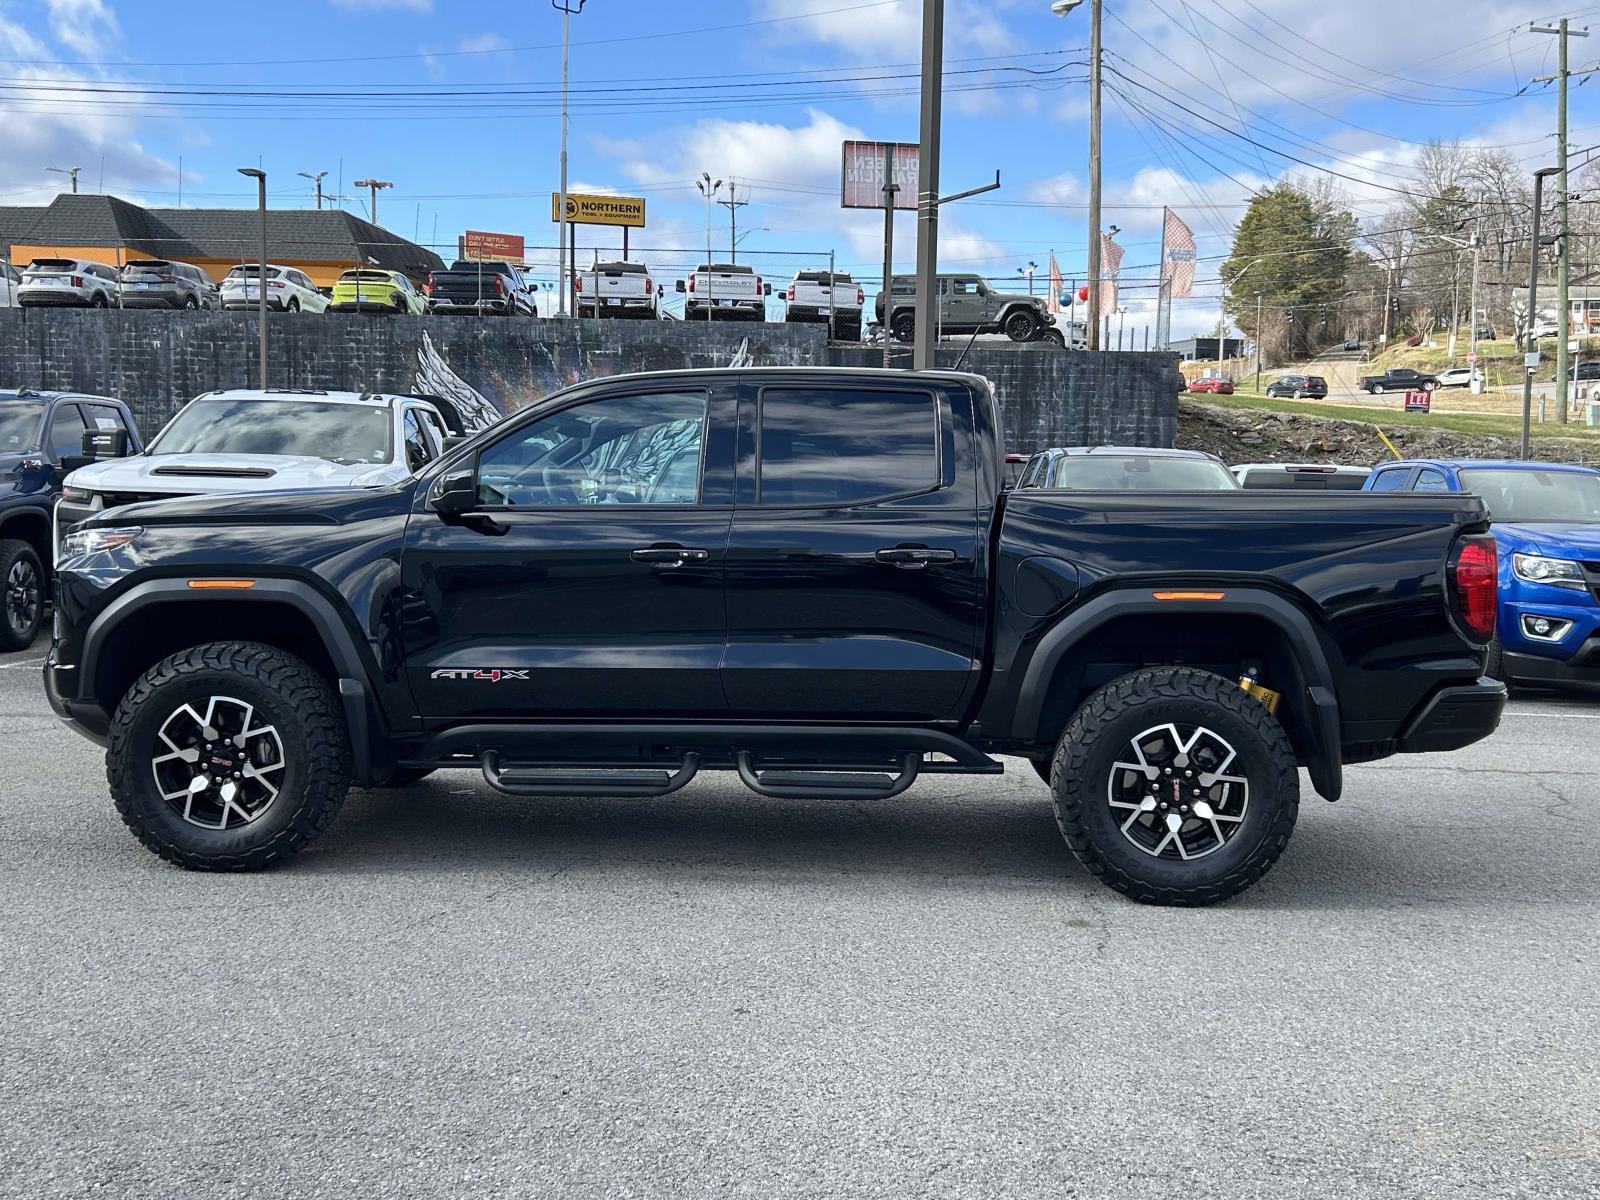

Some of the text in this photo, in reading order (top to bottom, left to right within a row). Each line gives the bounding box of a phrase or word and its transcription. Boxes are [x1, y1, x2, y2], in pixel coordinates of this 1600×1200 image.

[581, 201, 641, 213] NORTHERN
[1409, 395, 1428, 404] LEE
[431, 669, 530, 683] AT4X
